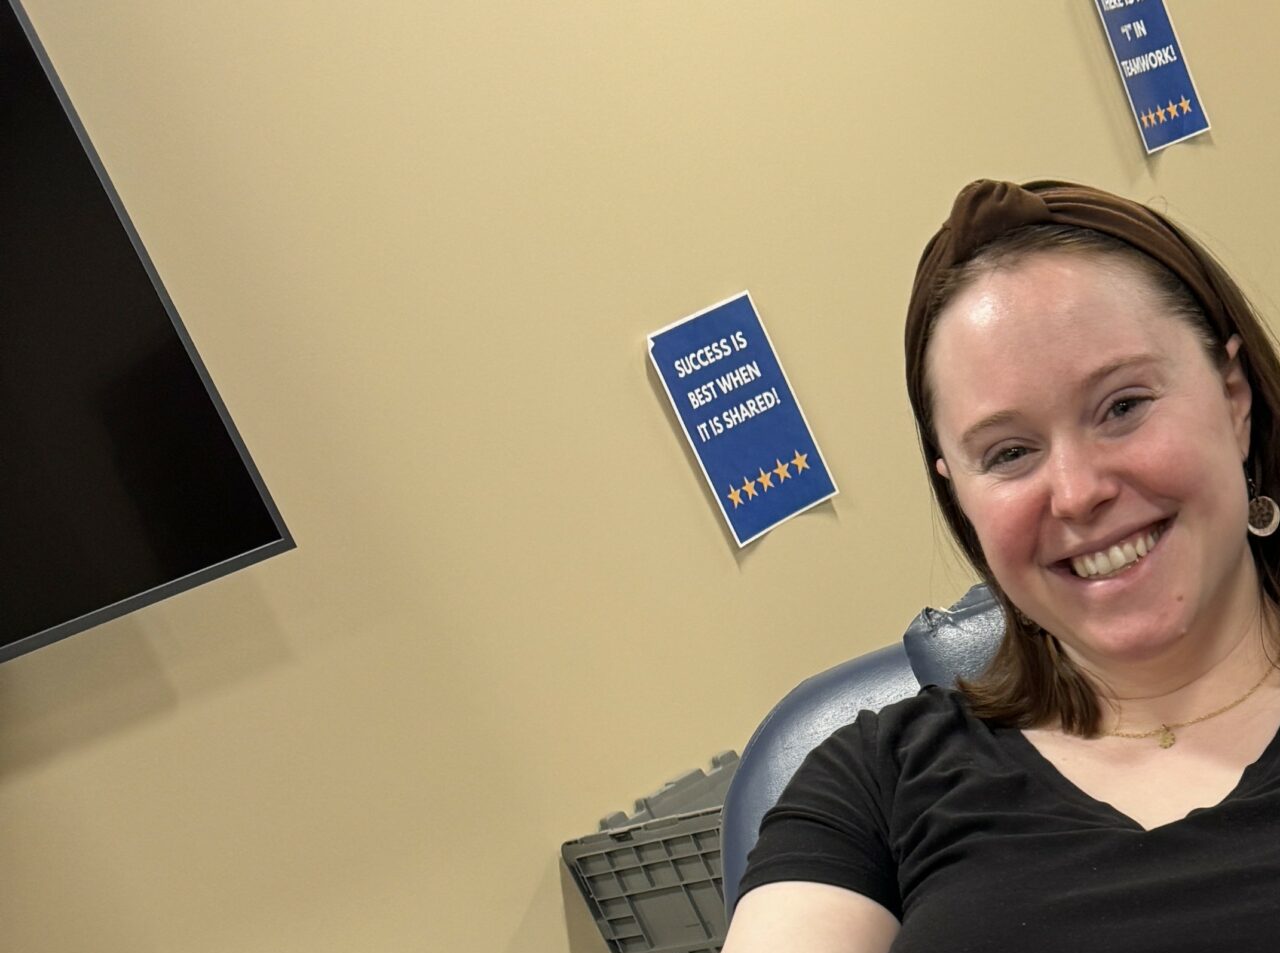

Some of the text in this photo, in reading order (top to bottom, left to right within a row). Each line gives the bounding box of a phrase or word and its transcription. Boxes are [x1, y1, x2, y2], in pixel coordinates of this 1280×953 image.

[1132, 19, 1147, 38] IN
[1120, 44, 1177, 77] TEAMWORK!
[674, 331, 748, 378] SUCCESS IS
[687, 360, 762, 410] BEST WHEN
[696, 387, 781, 443] IT IS SHARED!
